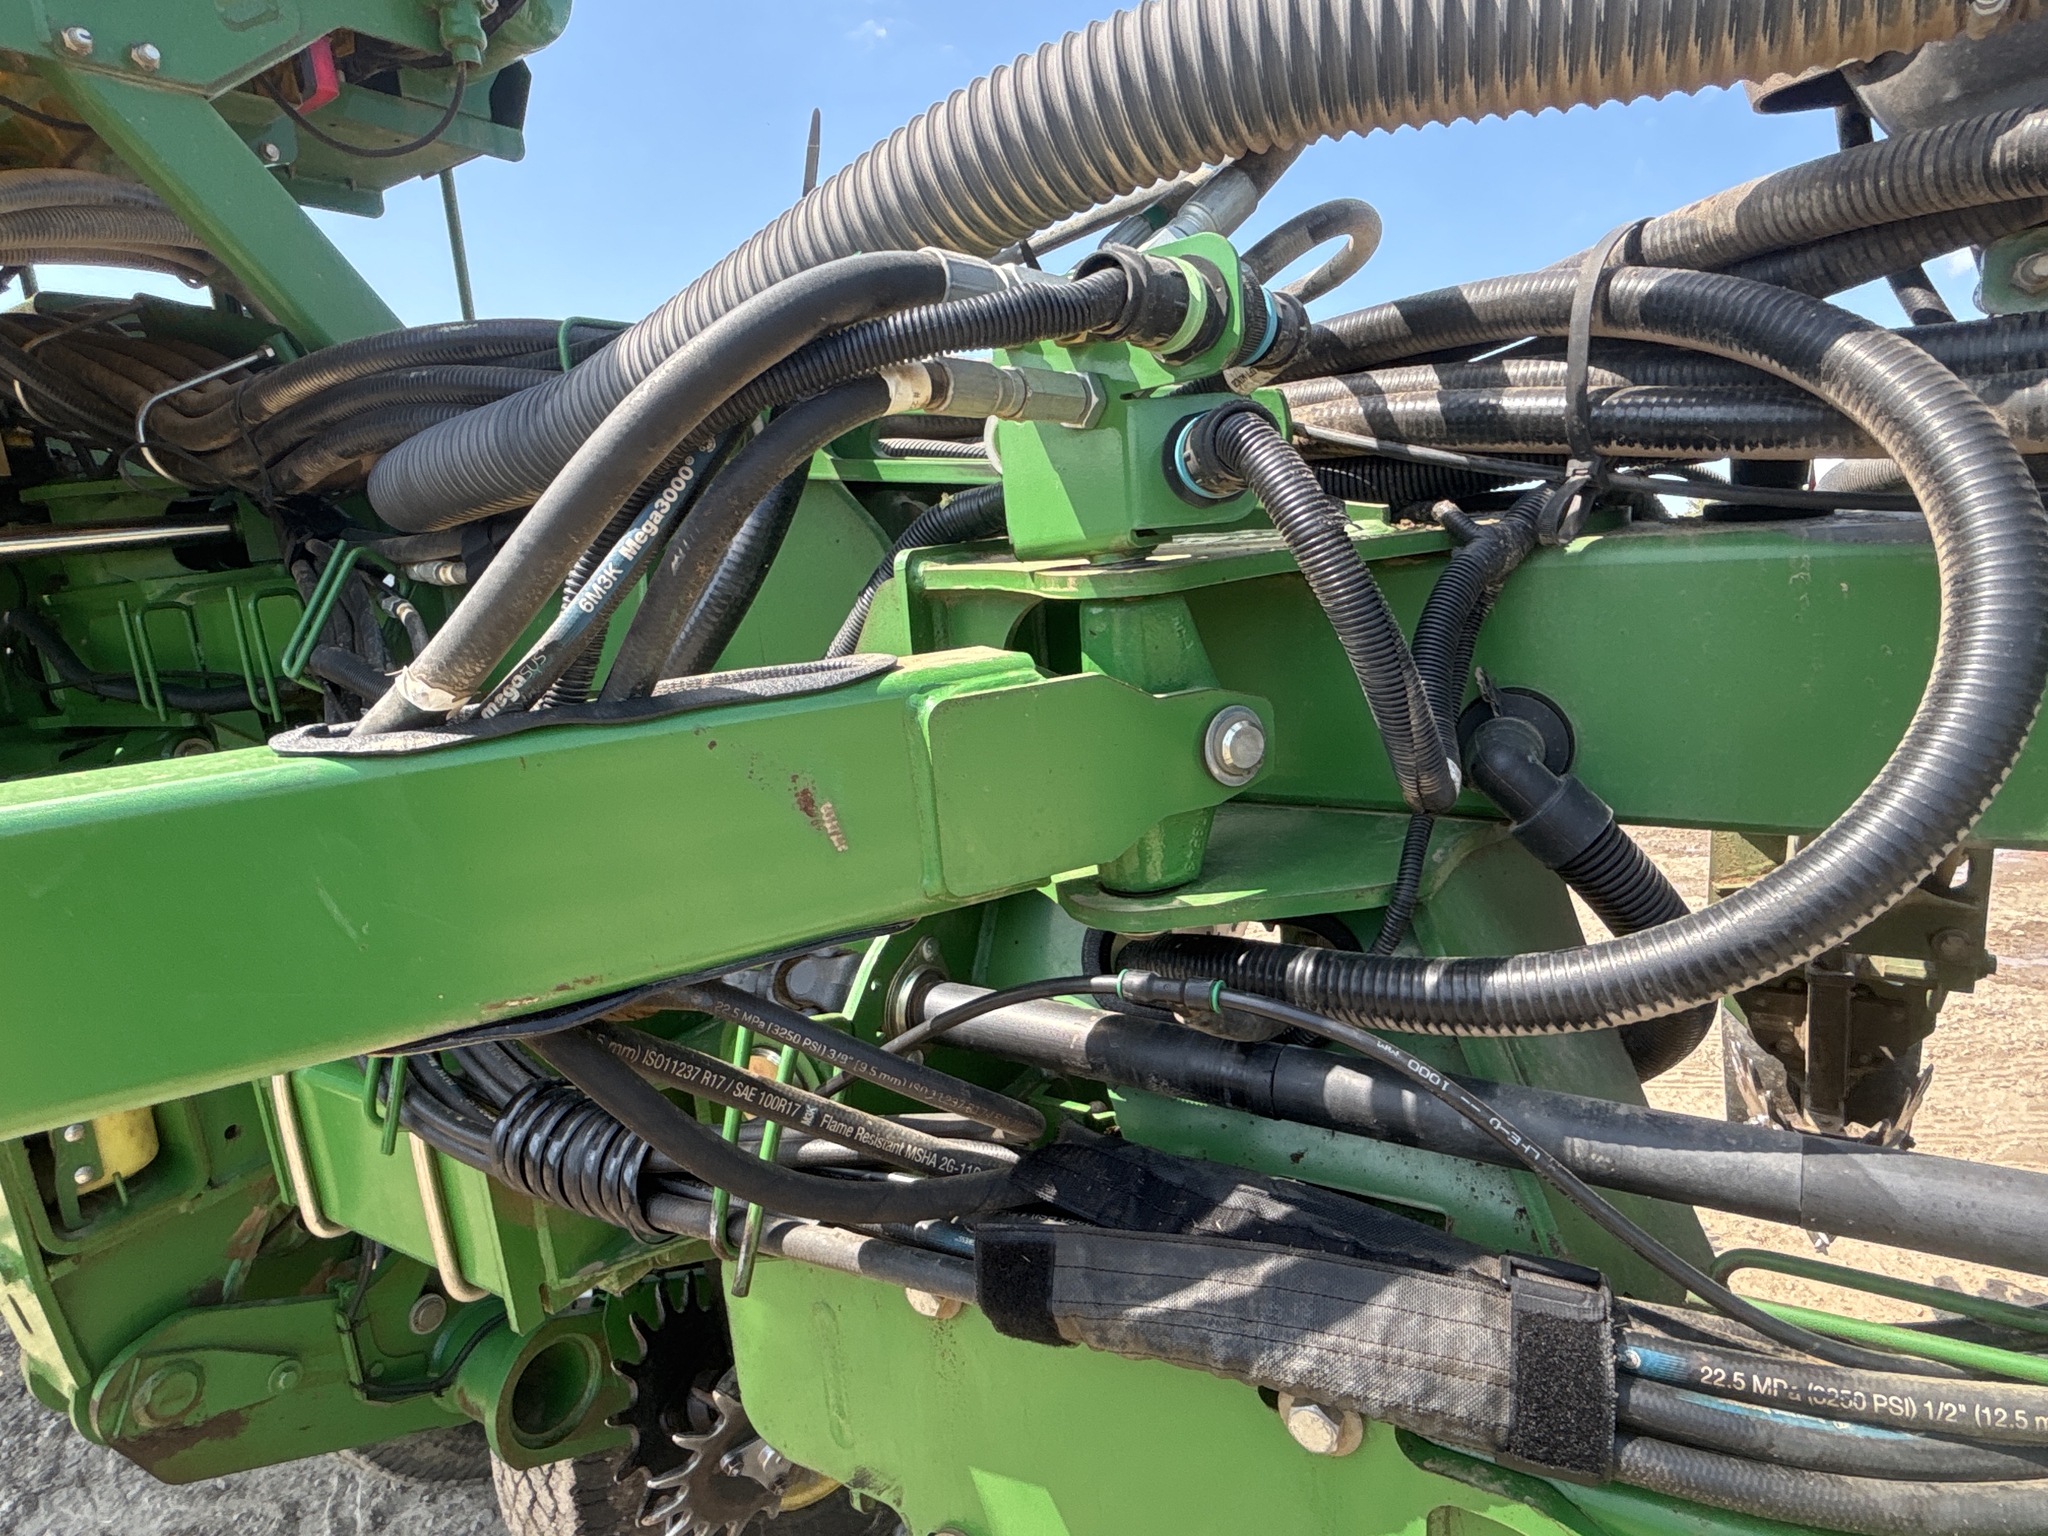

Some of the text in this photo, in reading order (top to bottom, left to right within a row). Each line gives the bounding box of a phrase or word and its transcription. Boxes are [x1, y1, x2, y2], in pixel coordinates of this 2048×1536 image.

[480, 652, 547, 719] megasys
[578, 562, 624, 613] 6M3K
[741, 1010, 766, 1030] MPa
[1407, 1058, 1451, 1091] 1000
[642, 1049, 701, 1080] ISO11237
[700, 1072, 727, 1091] R17
[724, 1079, 735, 1093] /
[733, 1081, 759, 1102] SAE
[758, 1091, 802, 1118] 100R17
[819, 1113, 854, 1138] Flame
[854, 1127, 905, 1157] Resistant
[904, 1143, 938, 1170] MSHA
[1700, 1365, 1746, 1391] 22.5
[1872, 1394, 1918, 1419] PSI)
[1924, 1400, 1967, 1422] 1/2"
[1975, 1404, 2029, 1430] (12.5
